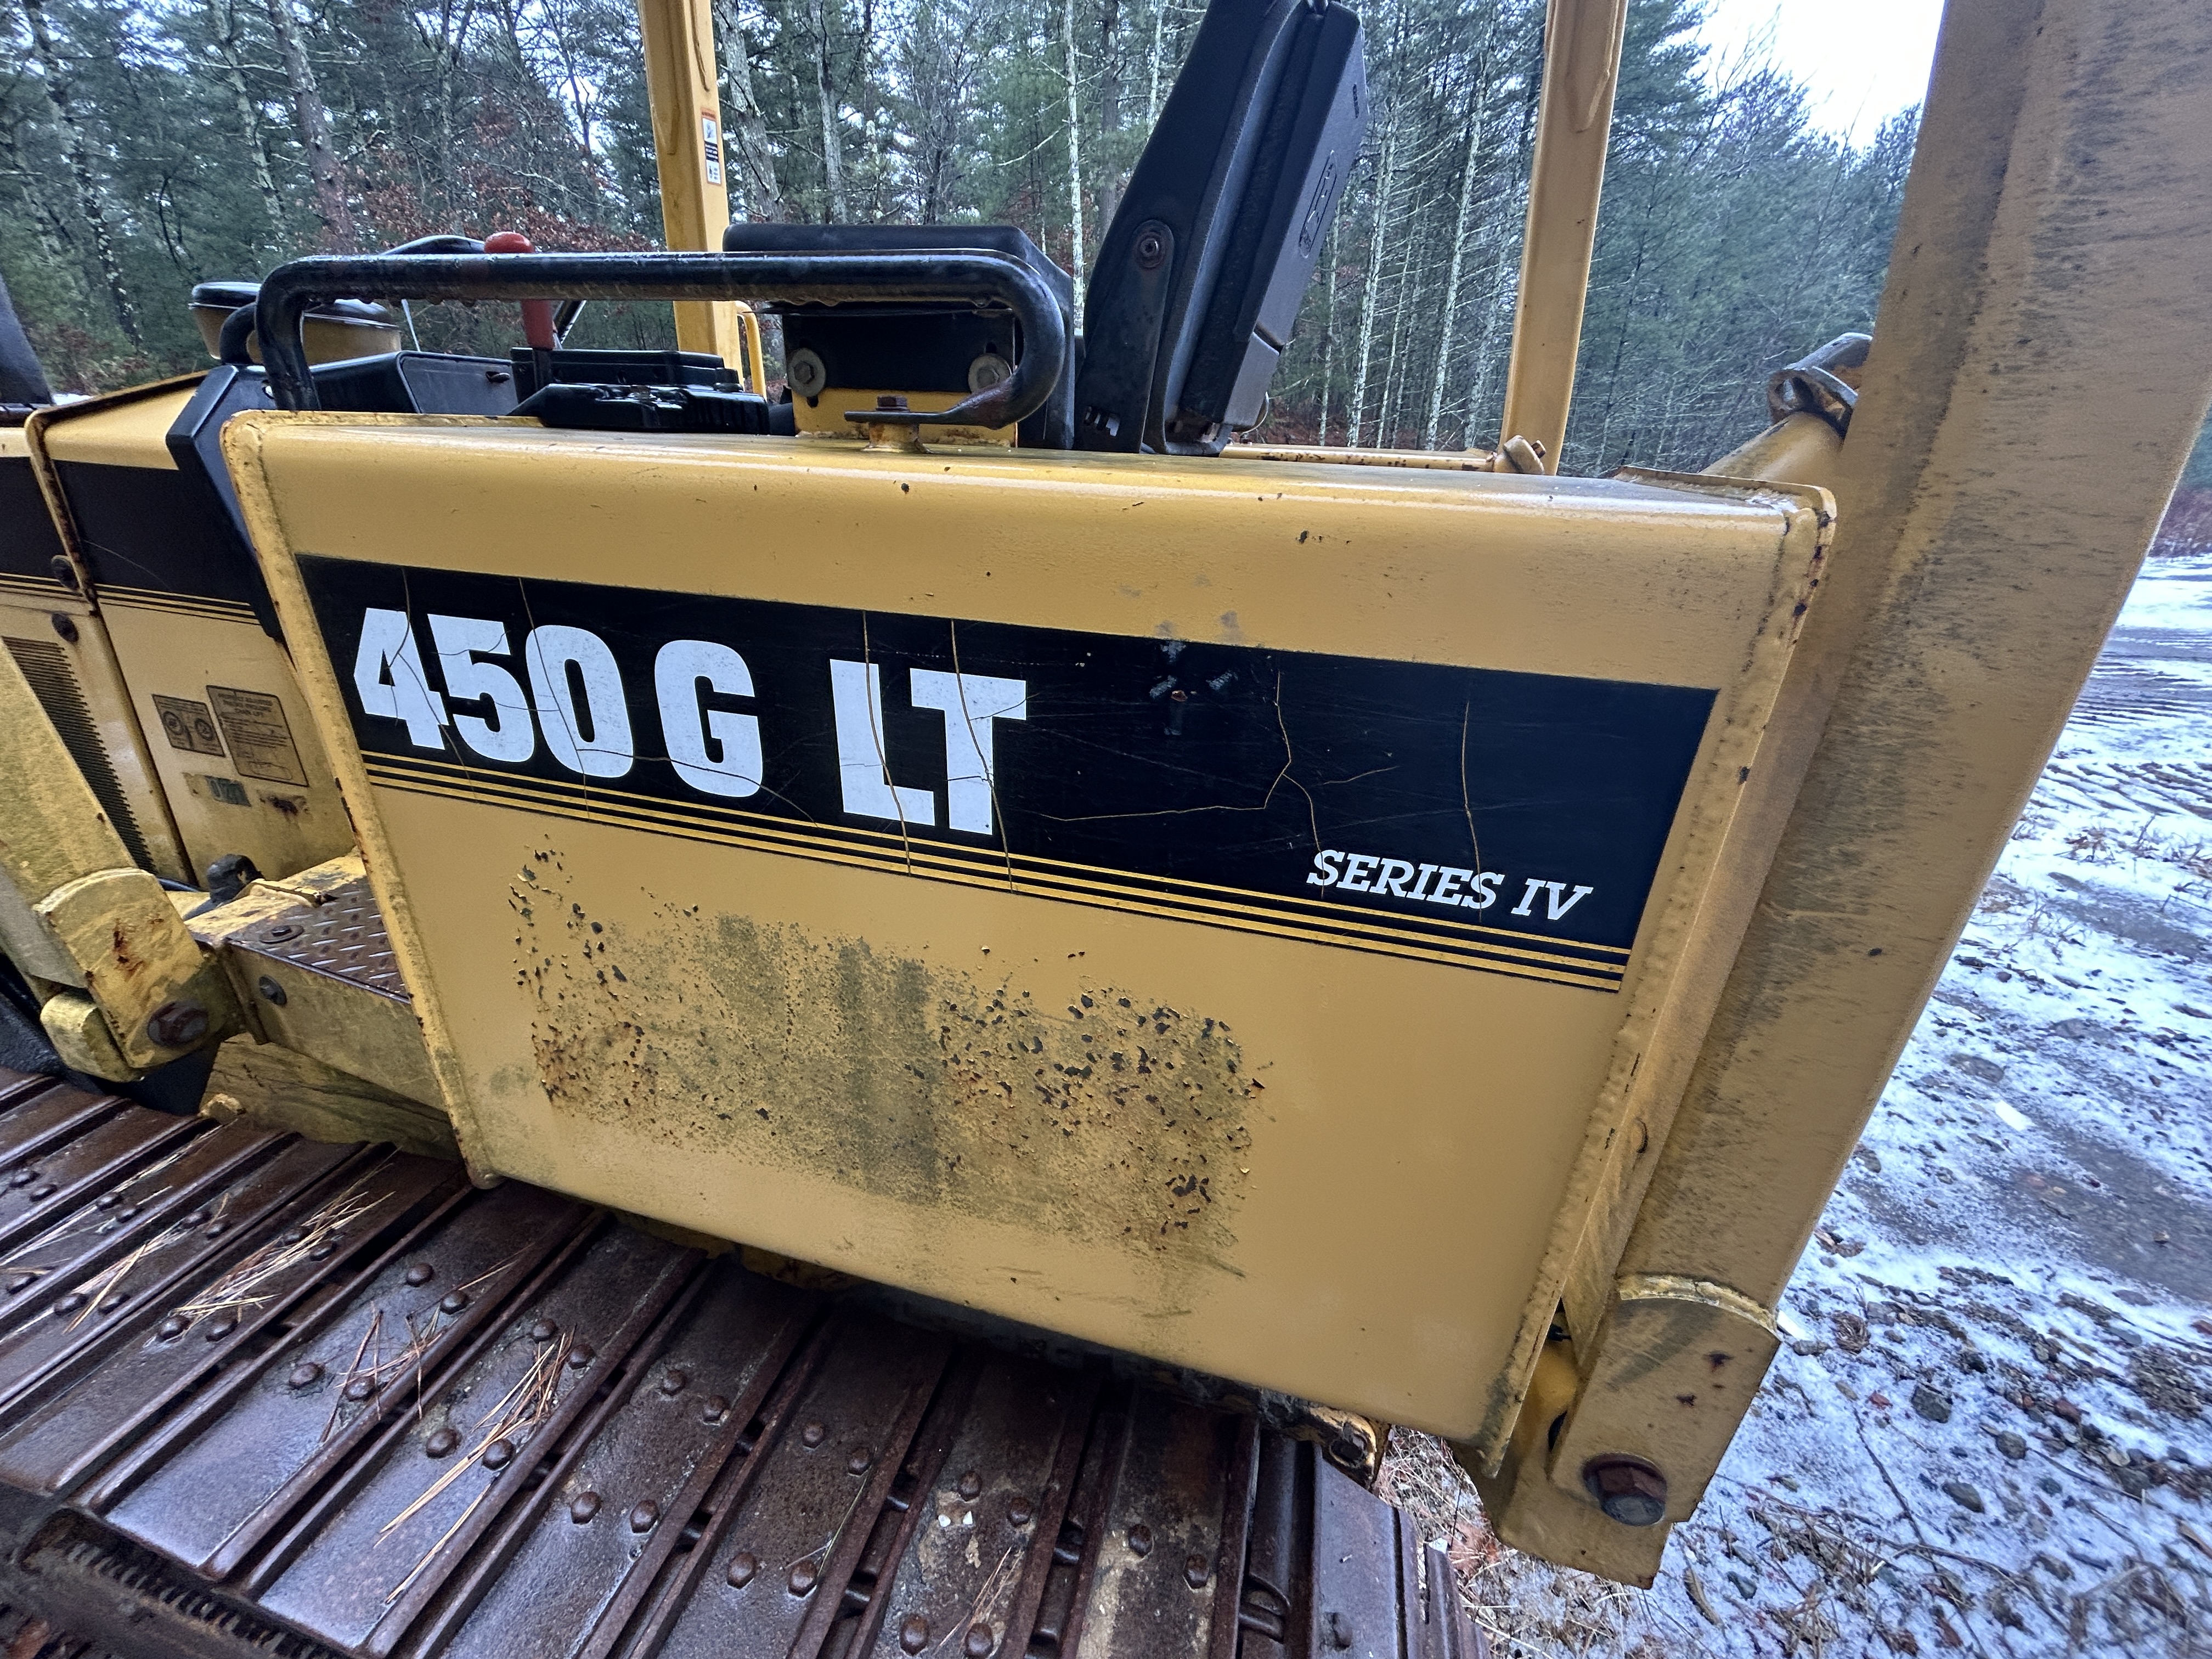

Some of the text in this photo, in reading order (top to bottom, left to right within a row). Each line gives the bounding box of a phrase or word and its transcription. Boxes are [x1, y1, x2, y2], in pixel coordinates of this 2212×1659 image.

[830, 659, 1027, 836] LT
[1306, 849, 1594, 921] SERIES IV
